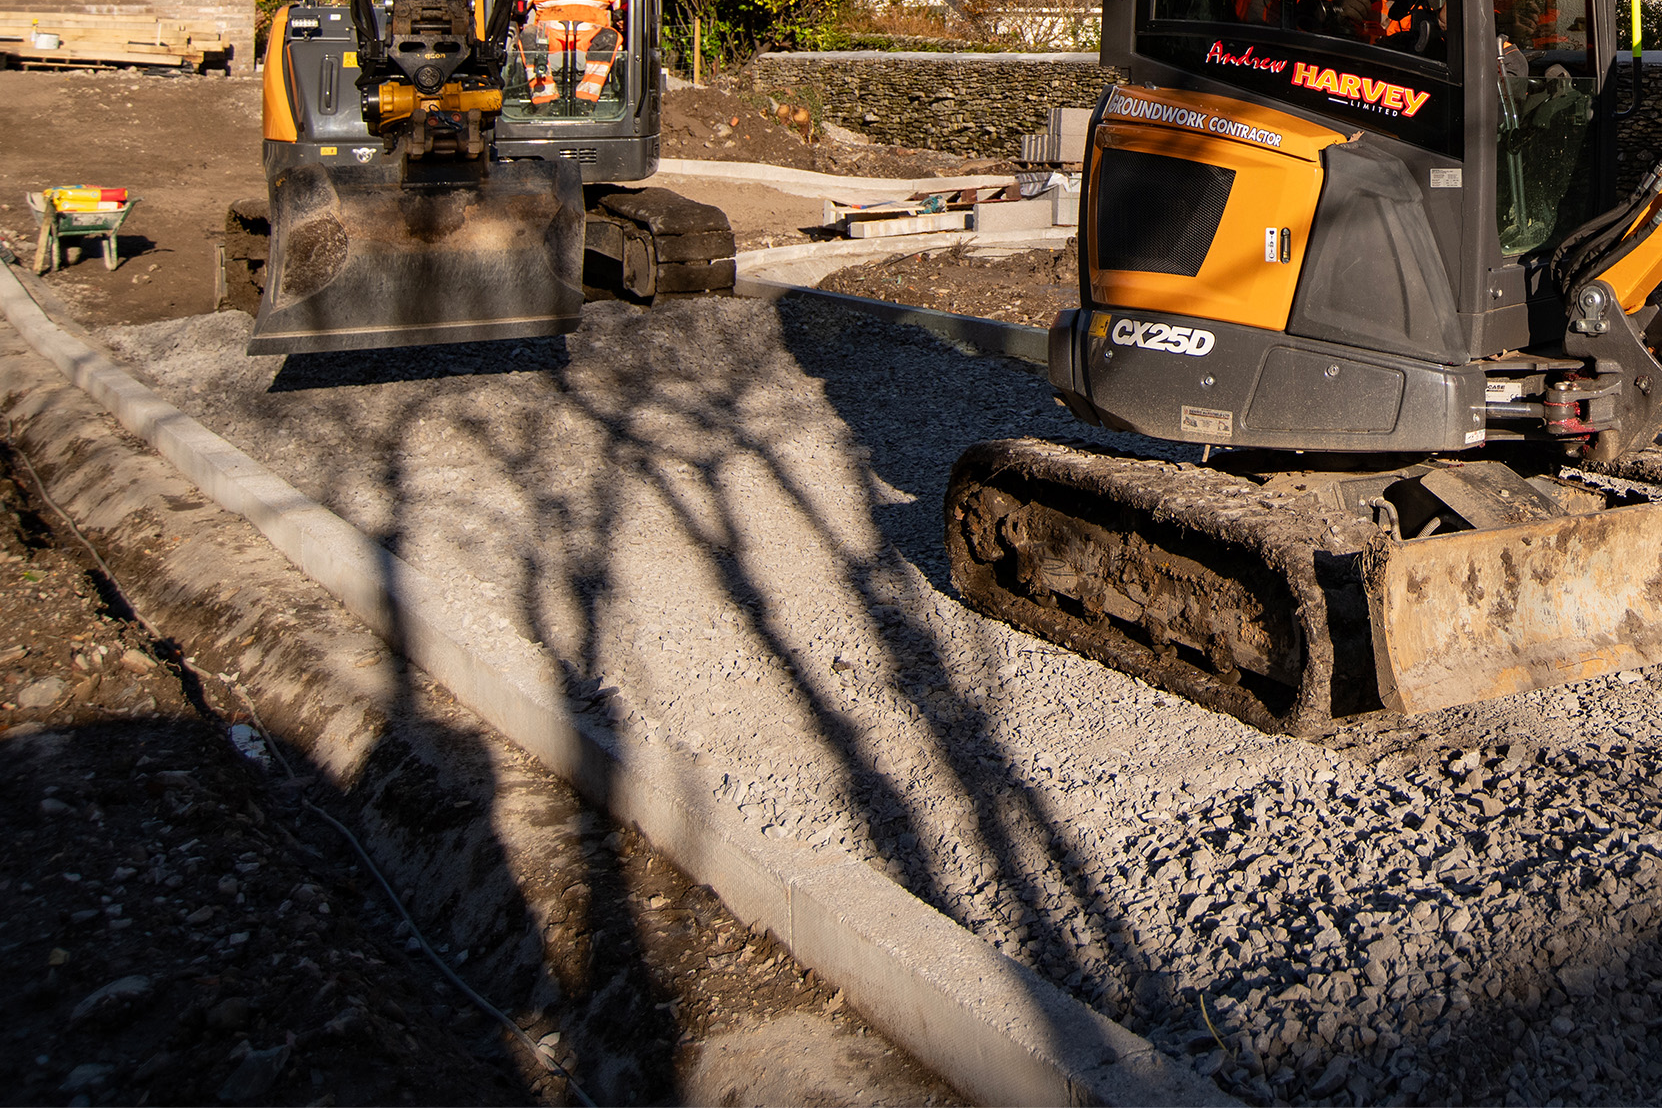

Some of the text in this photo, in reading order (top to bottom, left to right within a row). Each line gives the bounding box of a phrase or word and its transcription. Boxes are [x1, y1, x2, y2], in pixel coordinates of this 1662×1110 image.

[1205, 40, 1430, 117] Andrew HARVEY
[1108, 94, 1282, 147] GROUNDWORK CONTRACTOR
[1350, 100, 1398, 117] LIMITED
[1111, 318, 1217, 357] CX25D
